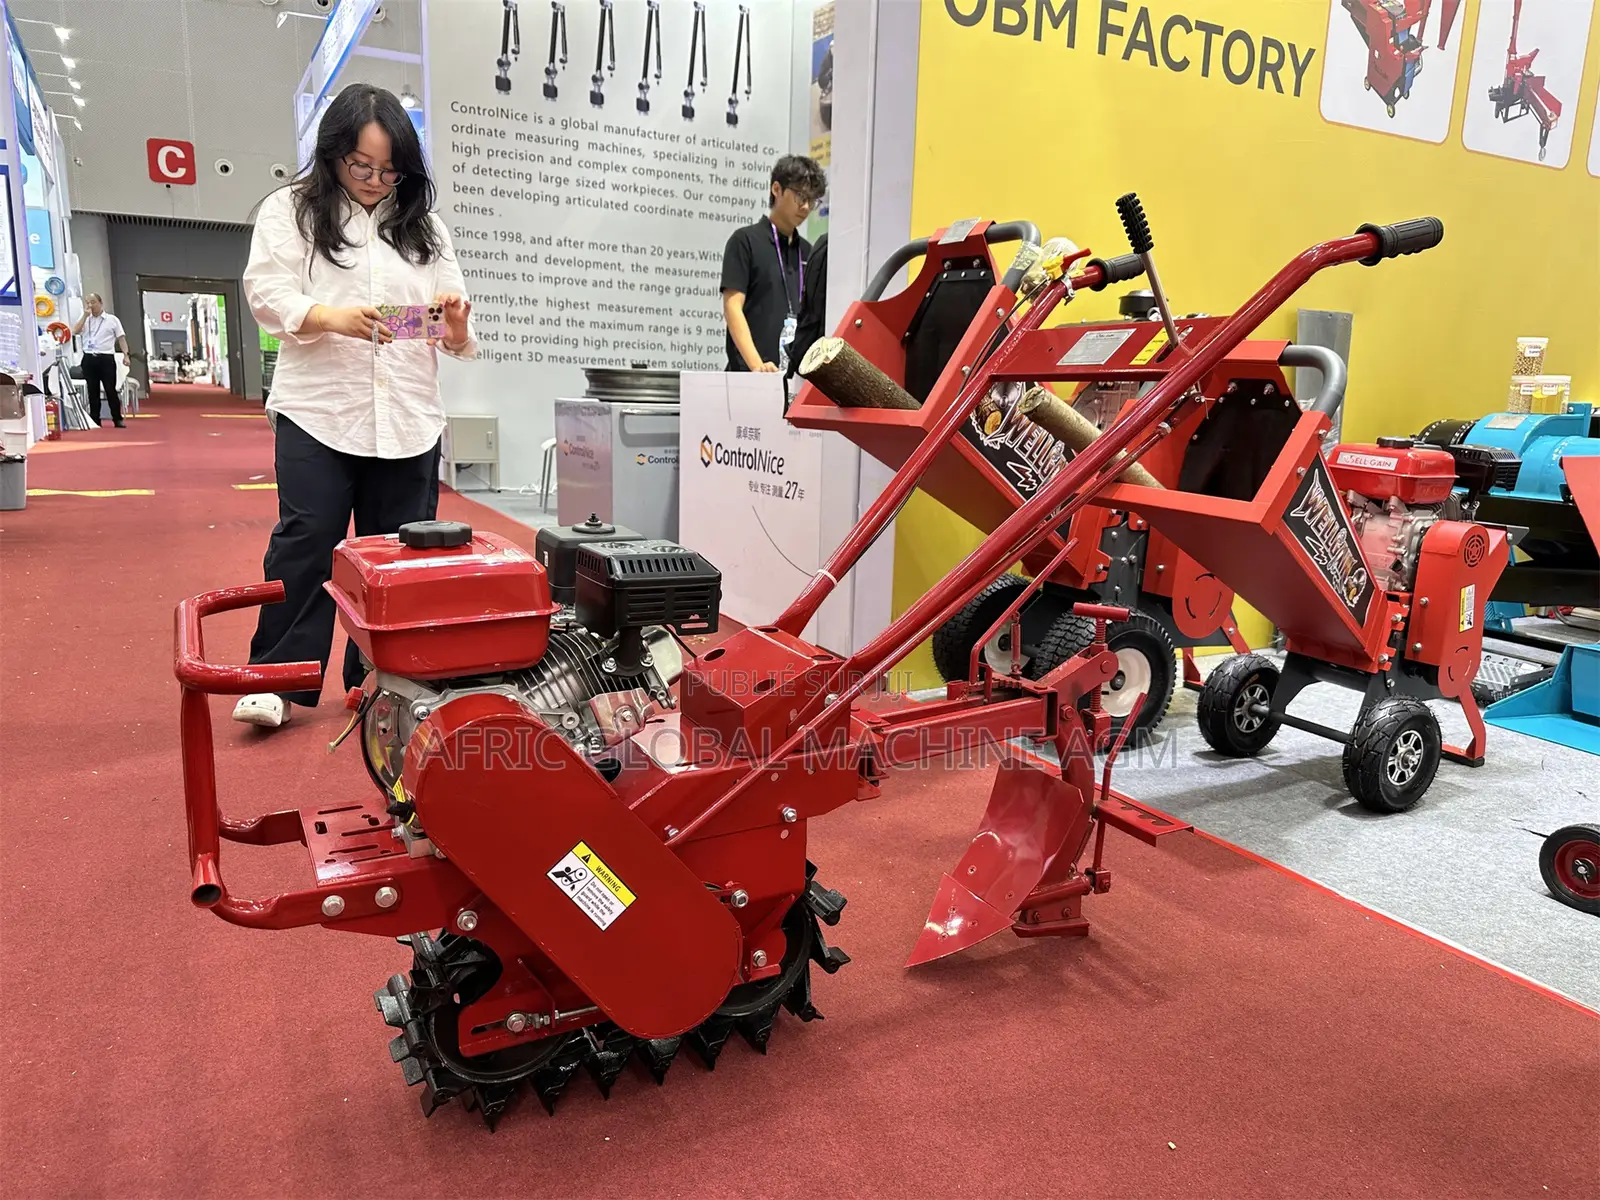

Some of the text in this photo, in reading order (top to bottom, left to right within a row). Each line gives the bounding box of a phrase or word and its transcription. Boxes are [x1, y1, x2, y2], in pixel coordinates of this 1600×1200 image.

[1097, 0, 1316, 97] FACTORY
[450, 101, 528, 122] ControlNice
[534, 112, 543, 124] is
[549, 117, 555, 125] a
[561, 117, 598, 130] global
[604, 124, 680, 143] manufacturer
[686, 134, 696, 145] of
[701, 137, 758, 154] articulated
[158, 146, 186, 178] C
[452, 123, 772, 172] ordinate measuring machines, specializing in solvin
[452, 142, 480, 157] high
[487, 148, 544, 162] precision
[550, 156, 572, 166] and
[578, 159, 627, 173] complex
[708, 174, 728, 186] The
[732, 178, 770, 190] difficul
[452, 162, 466, 174] of
[472, 164, 532, 184] detecting
[539, 172, 570, 188] large
[576, 176, 606, 190] sized
[611, 181, 678, 199] workpieces.
[684, 189, 703, 201] Our
[708, 194, 756, 210] company
[453, 182, 754, 225] been developing articulated coordinate measuring
[454, 202, 494, 216] chines
[454, 226, 488, 240] Since
[493, 230, 526, 245] 1998,
[530, 236, 552, 246] and
[556, 237, 584, 249] after
[588, 241, 618, 252] more
[622, 244, 646, 256] than
[650, 246, 664, 256] 20
[456, 248, 722, 279] research and development, the measuremen
[462, 268, 516, 280] ontinues
[522, 272, 534, 282] to
[539, 272, 588, 287] improve
[592, 278, 612, 288] and
[618, 280, 635, 290] the
[640, 283, 670, 295] range
[163, 312, 170, 320] C
[506, 312, 534, 324] level
[539, 316, 560, 327] and
[566, 318, 585, 328] the
[590, 320, 644, 332] maximum
[648, 325, 680, 336] range
[684, 324, 692, 335] is
[696, 326, 702, 336] 9
[706, 328, 726, 336] met
[546, 297, 590, 312] highest
[598, 302, 672, 316] measurement
[680, 308, 724, 322] accuracy
[476, 331, 724, 355] ted to providing high precision, highly por
[476, 349, 522, 363] elligent
[527, 352, 543, 362] 3D
[548, 354, 626, 366] measurement
[672, 360, 722, 371] solutions.
[648, 455, 679, 464] Control
[715, 442, 784, 475] ControlNice
[596, 865, 621, 892] WARNING
